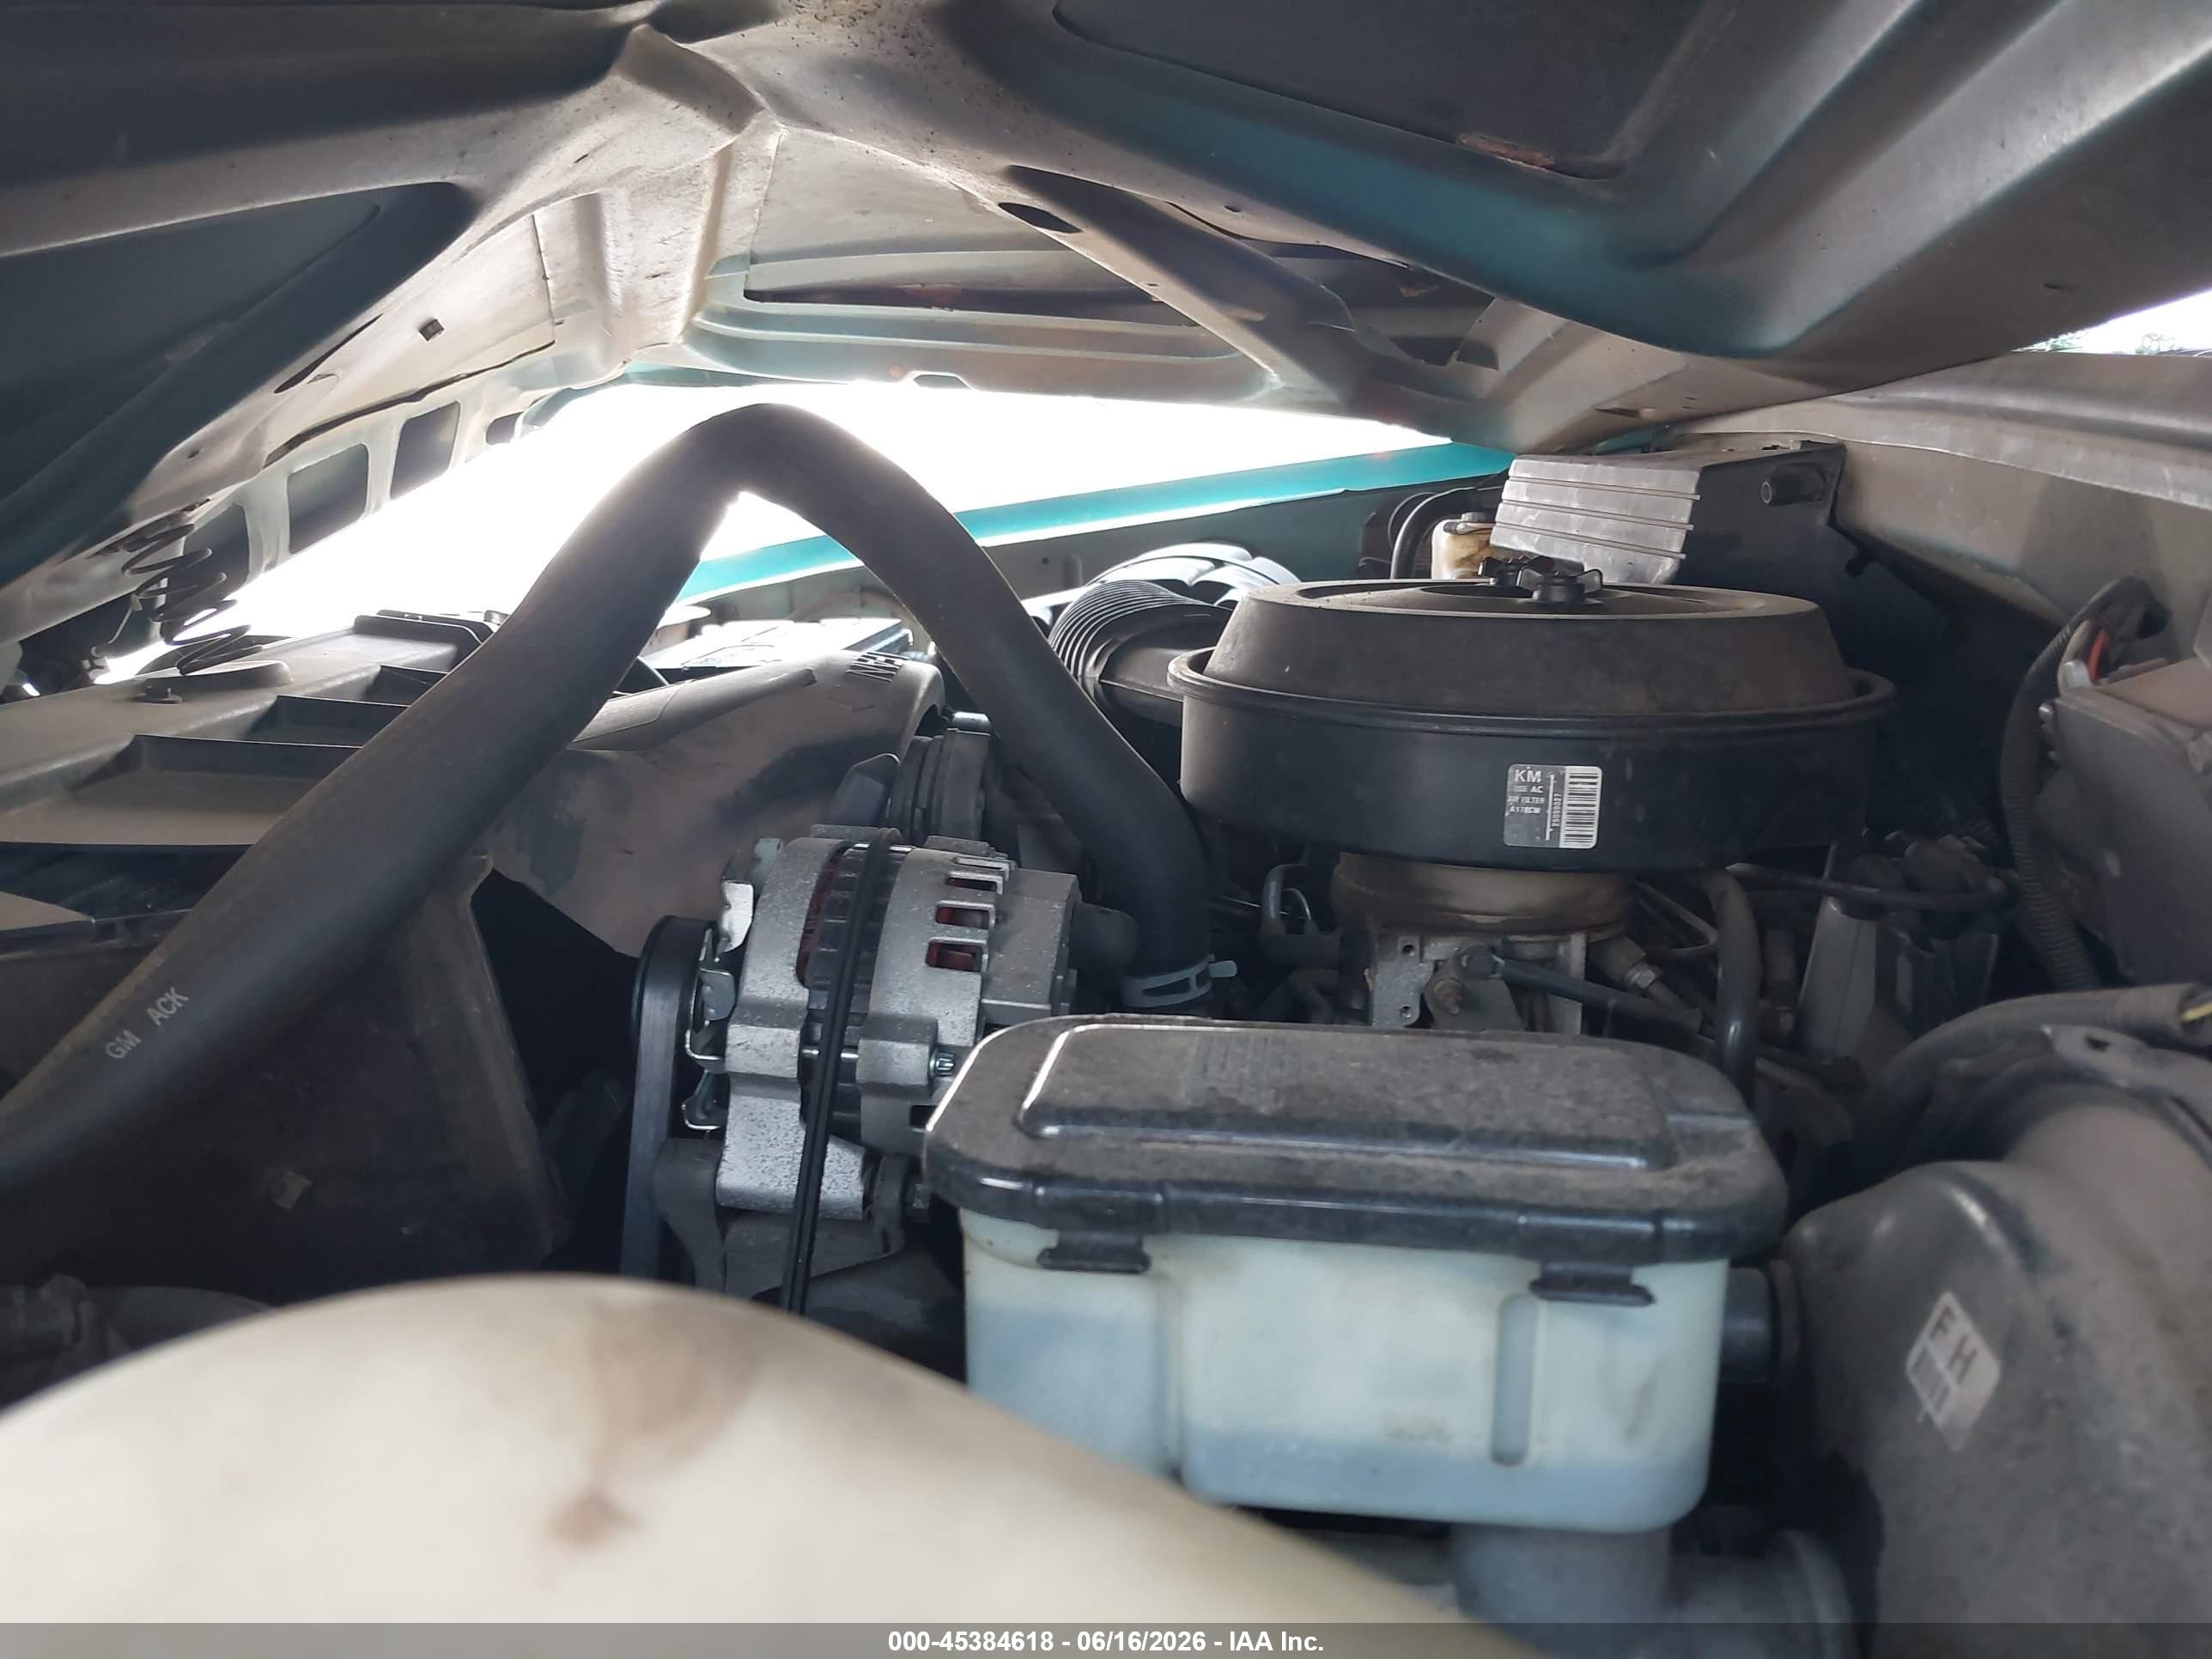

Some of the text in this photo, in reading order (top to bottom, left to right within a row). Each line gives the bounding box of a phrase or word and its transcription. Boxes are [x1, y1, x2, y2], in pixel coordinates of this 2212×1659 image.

[1514, 769, 1542, 783] KM
[1530, 785, 1544, 793] AC
[105, 986, 190, 1058] GM ACK
